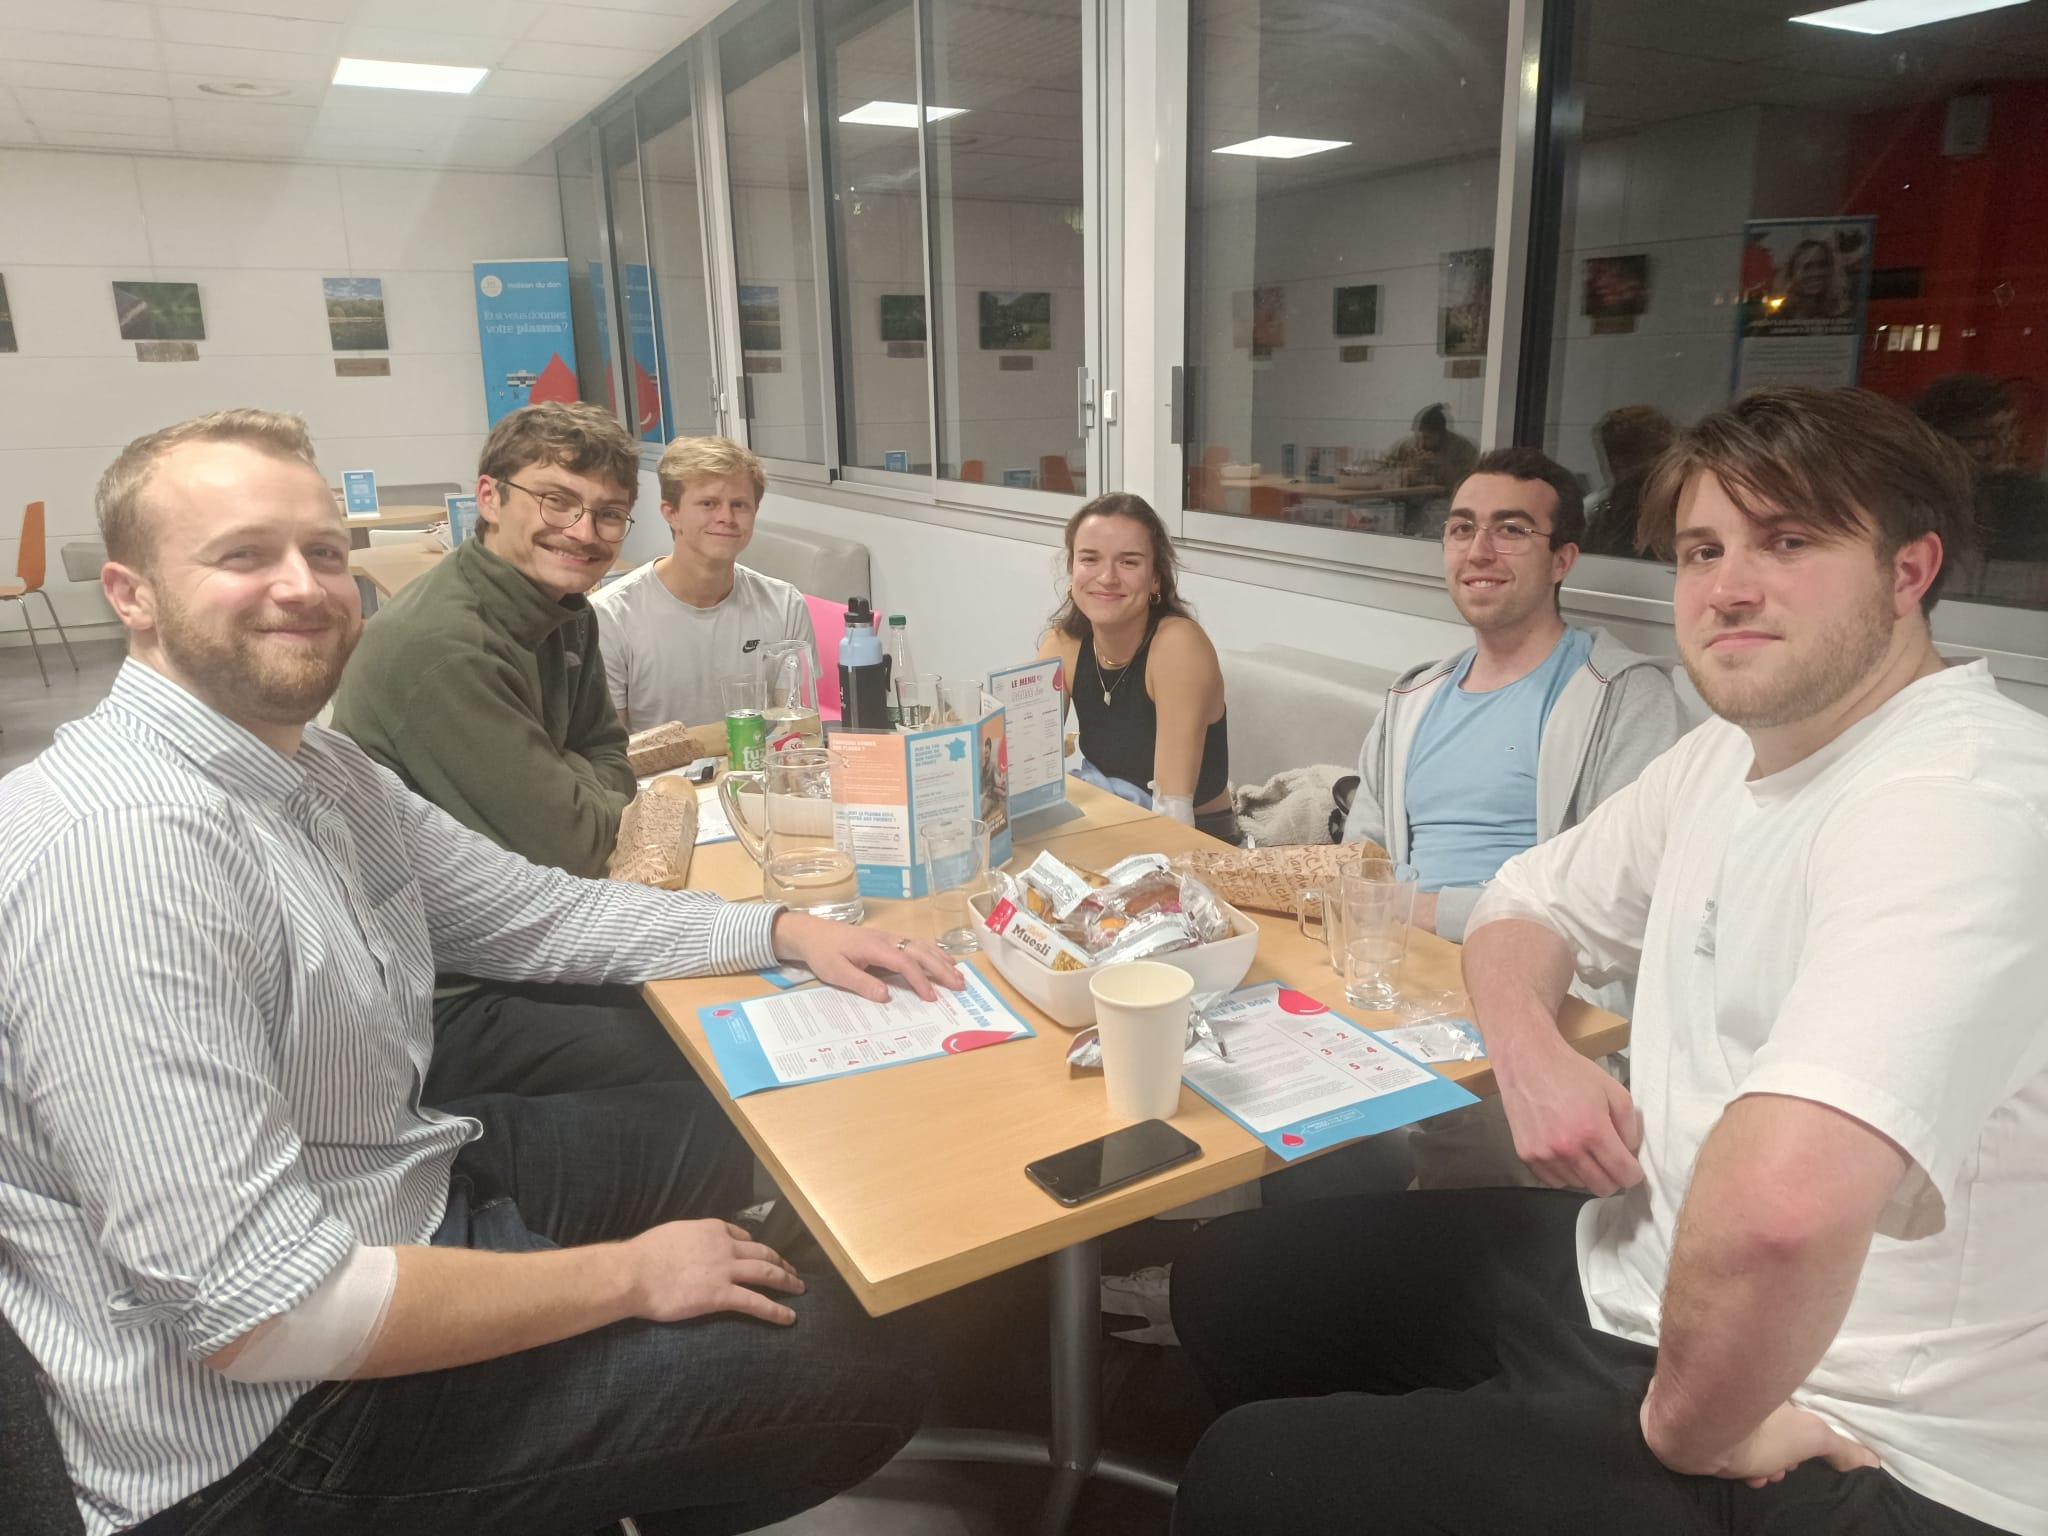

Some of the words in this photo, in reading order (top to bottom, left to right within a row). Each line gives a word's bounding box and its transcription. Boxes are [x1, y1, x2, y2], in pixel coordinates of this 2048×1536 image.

[516, 323, 561, 336] plasma
[1011, 679, 1018, 688] LE
[1019, 674, 1037, 687] MENU
[1012, 923, 1052, 957] Muesli
[1247, 997, 1271, 1007] DON
[1336, 1031, 1349, 1040] 2
[1320, 1048, 1333, 1056] 3
[1366, 1046, 1378, 1054] 4
[1348, 1062, 1361, 1071] 5
